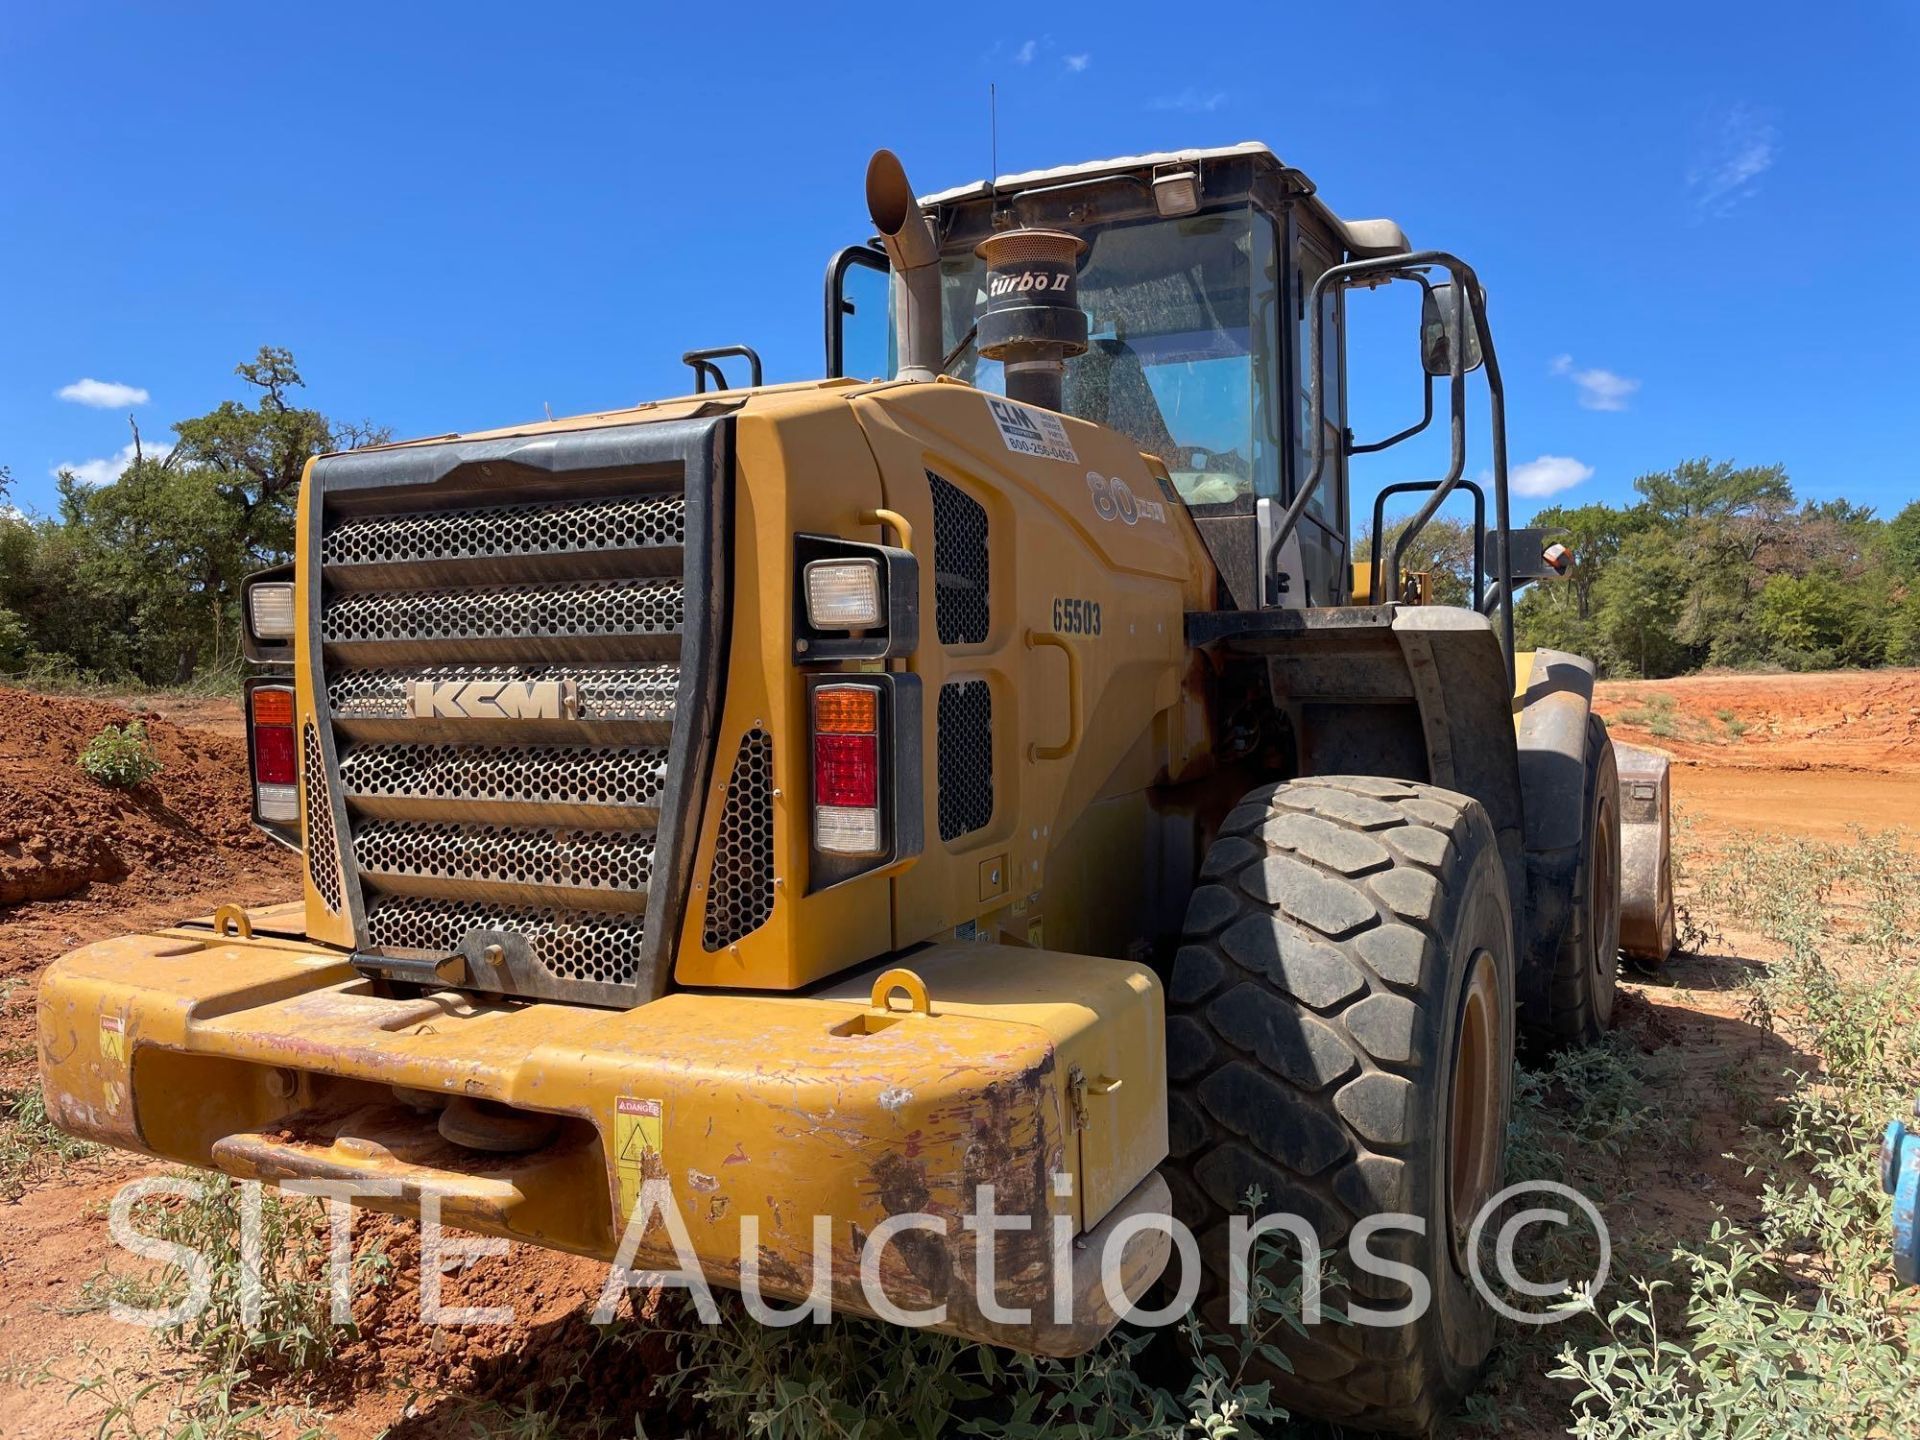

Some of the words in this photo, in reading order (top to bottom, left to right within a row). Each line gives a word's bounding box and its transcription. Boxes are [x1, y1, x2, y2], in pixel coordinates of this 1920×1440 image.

[1050, 273, 1070, 291] II
[989, 400, 1038, 430] CLM
[1053, 598, 1101, 636] 65503
[415, 681, 560, 719] KCM
